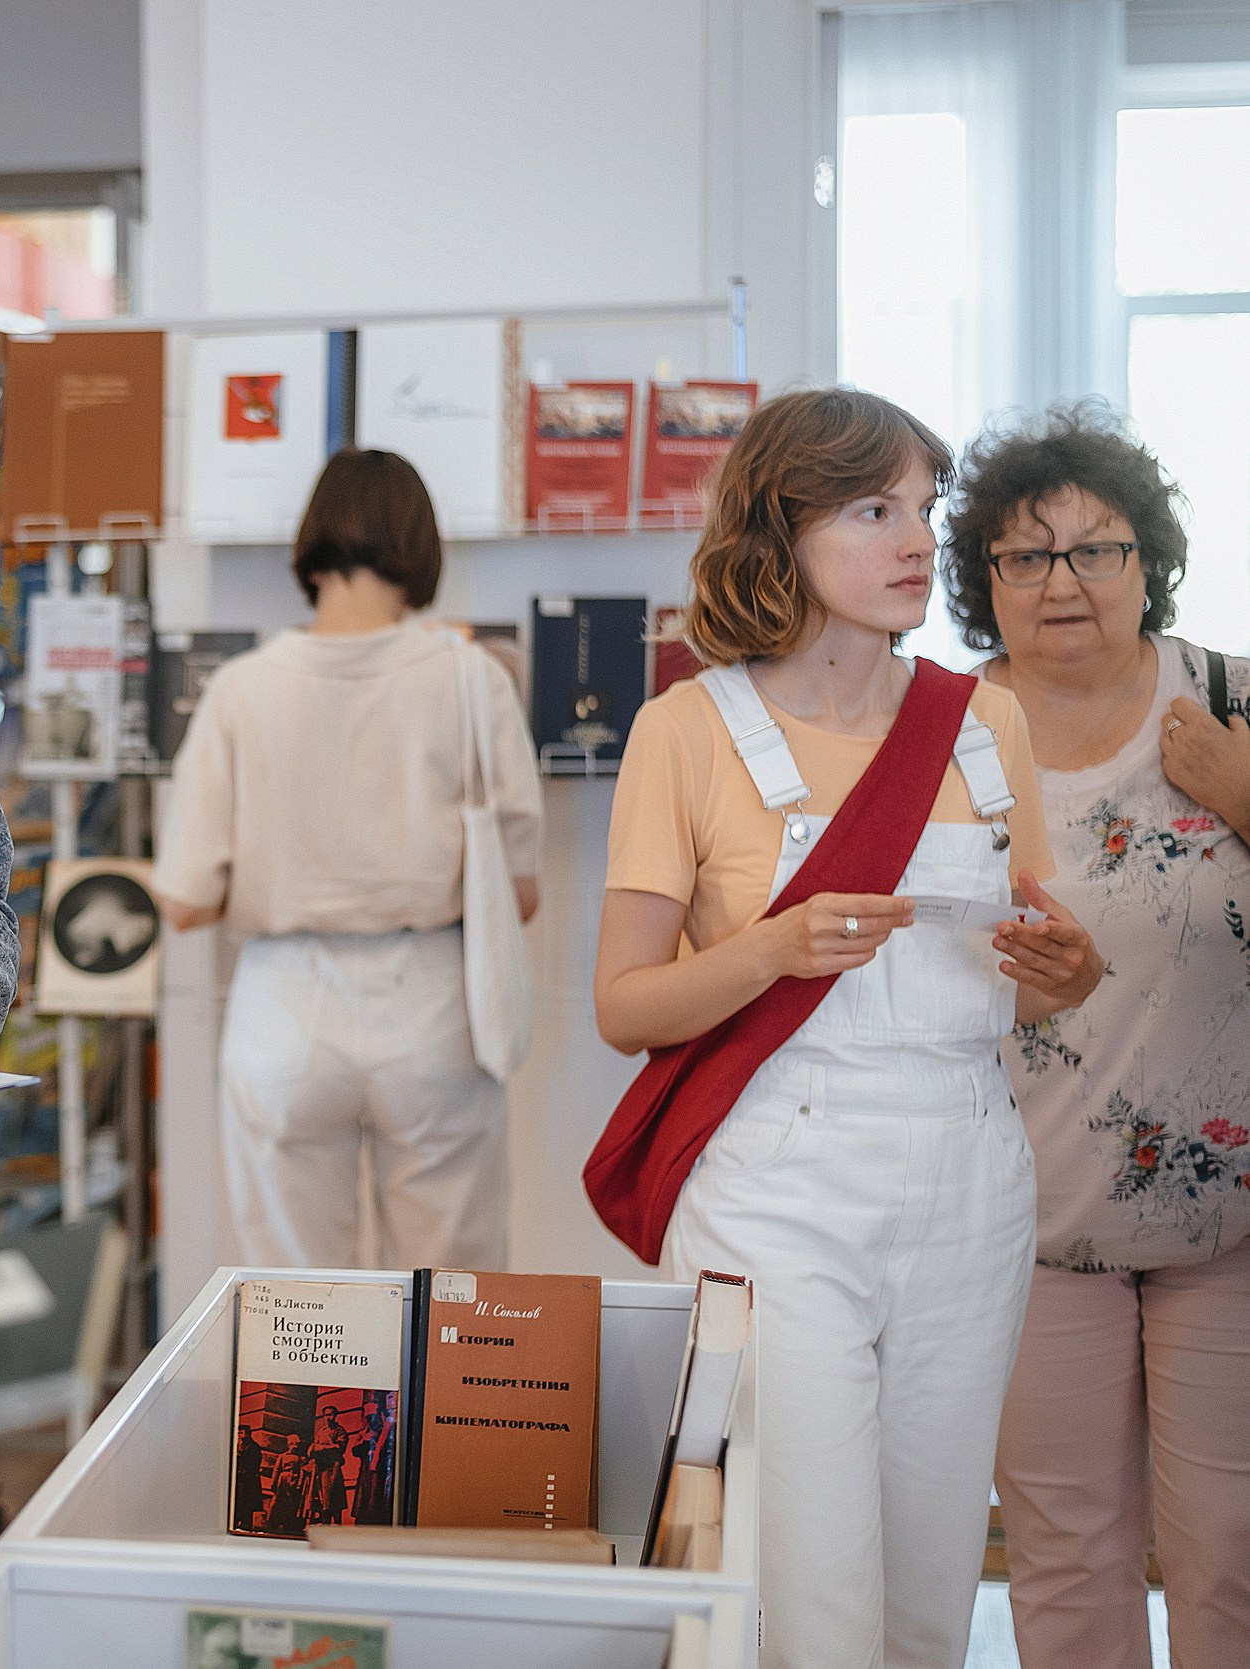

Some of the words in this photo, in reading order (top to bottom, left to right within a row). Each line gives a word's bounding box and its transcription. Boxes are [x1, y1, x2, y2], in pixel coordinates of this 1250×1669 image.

[474, 1301, 490, 1316] И.
[492, 1303, 543, 1319] Соколов
[273, 1316, 344, 1337] История
[272, 1335, 343, 1352] смотрит
[272, 1350, 281, 1360] в
[288, 1349, 369, 1367] объектив
[461, 1376, 570, 1391] ИЗОБРЕТЕНИЯ
[435, 1415, 571, 1433] КИНЕМАТОГРАФА
